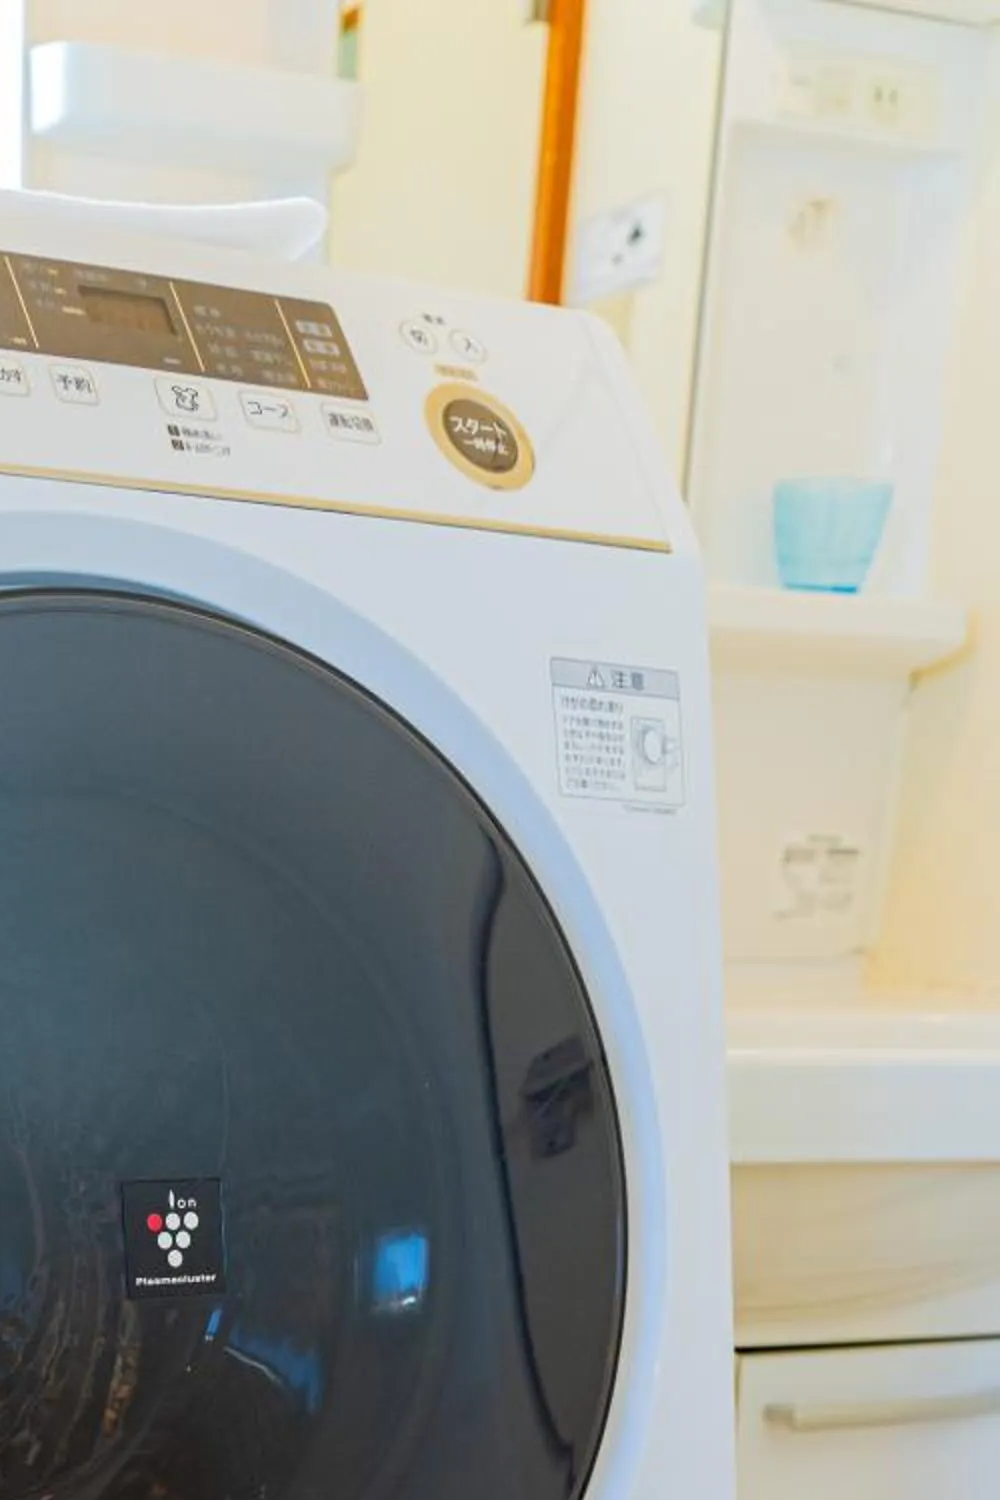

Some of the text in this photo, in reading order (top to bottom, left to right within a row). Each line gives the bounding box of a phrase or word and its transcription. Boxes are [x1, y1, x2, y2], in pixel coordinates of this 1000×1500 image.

[449, 416, 507, 439] スタート
[135, 1273, 216, 1286] Plasmacluster
